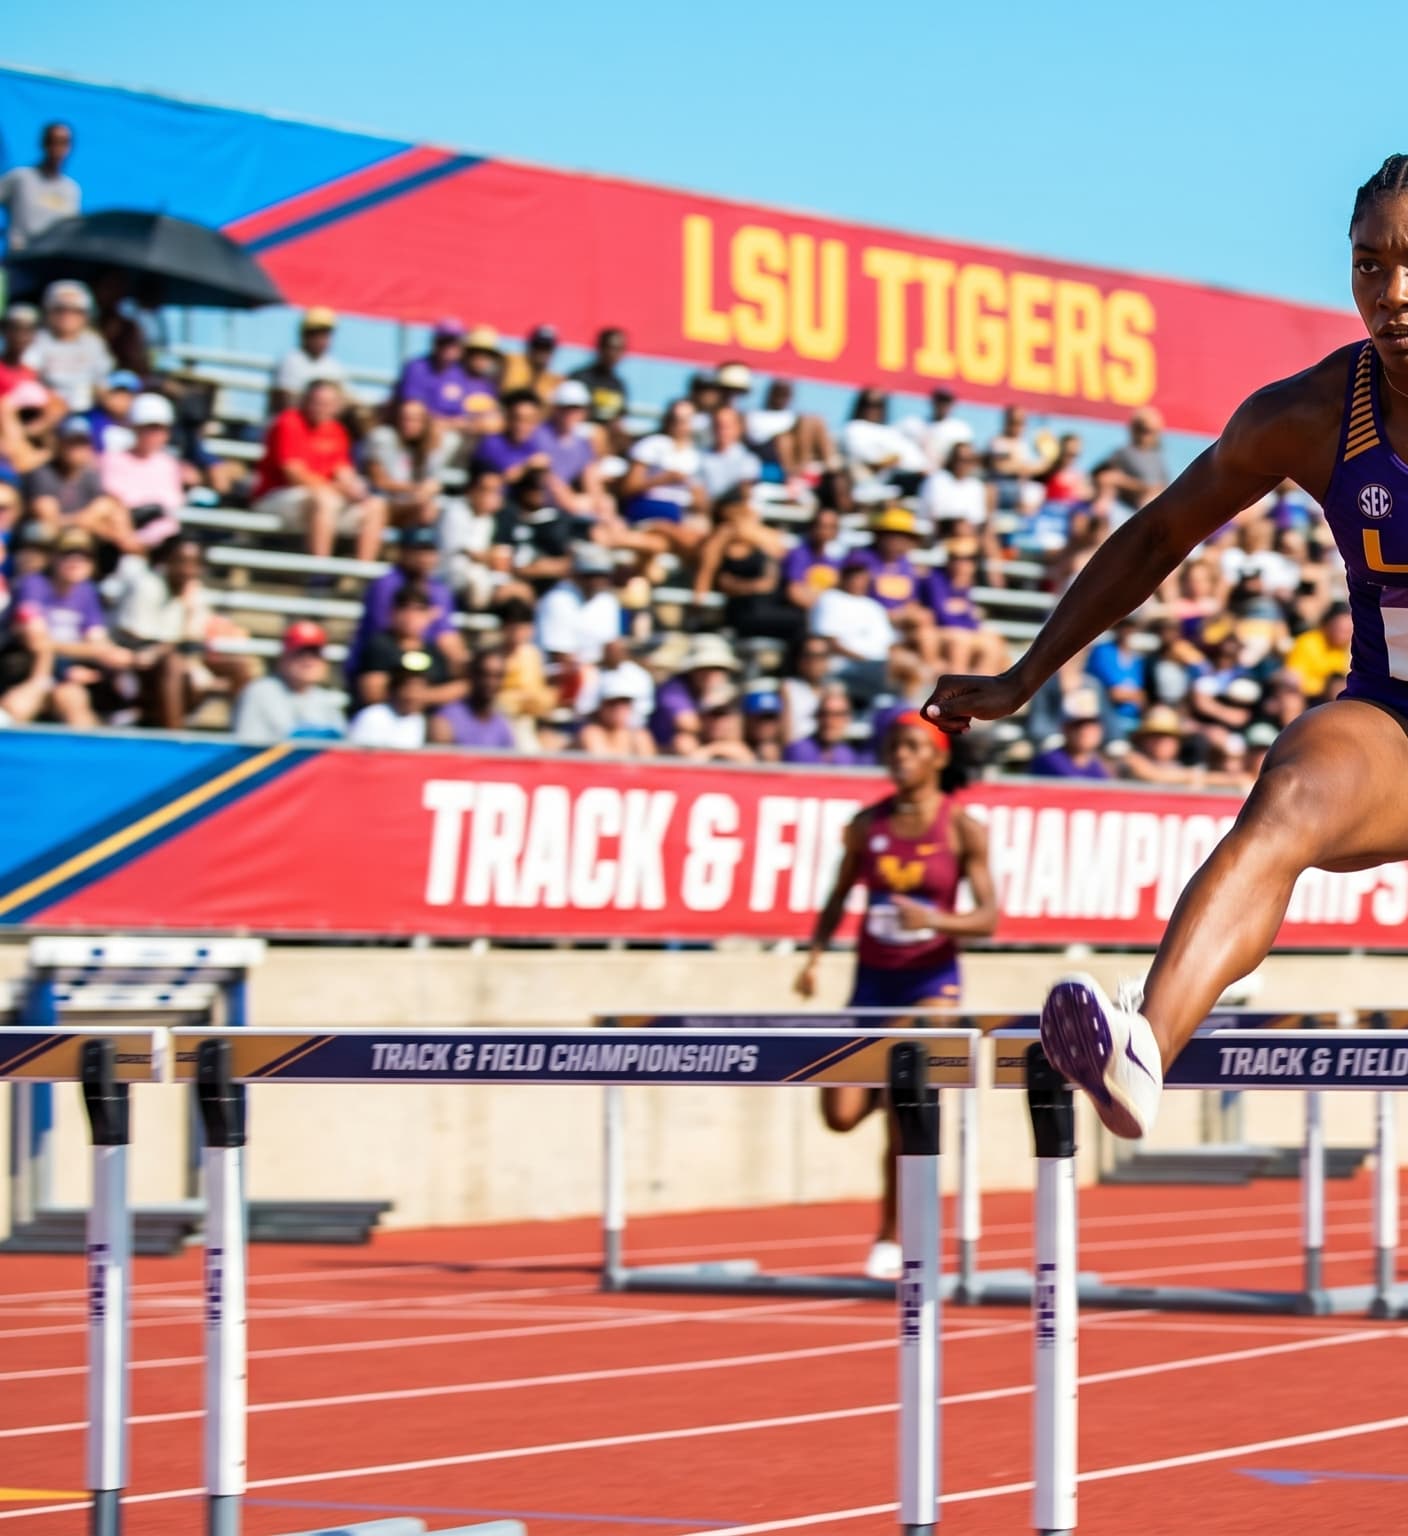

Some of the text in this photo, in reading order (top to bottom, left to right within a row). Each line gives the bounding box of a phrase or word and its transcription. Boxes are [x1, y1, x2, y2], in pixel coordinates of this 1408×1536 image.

[682, 214, 1156, 407] LSU TIGERS
[1360, 486, 1390, 517] SEC
[422, 779, 677, 909] TRACK
[680, 794, 743, 911] &
[372, 1043, 760, 1074] TRACK & FIELD CHAMPIONSHIPS
[1220, 1047, 1307, 1075] TRACK
[1310, 1047, 1332, 1076] &
